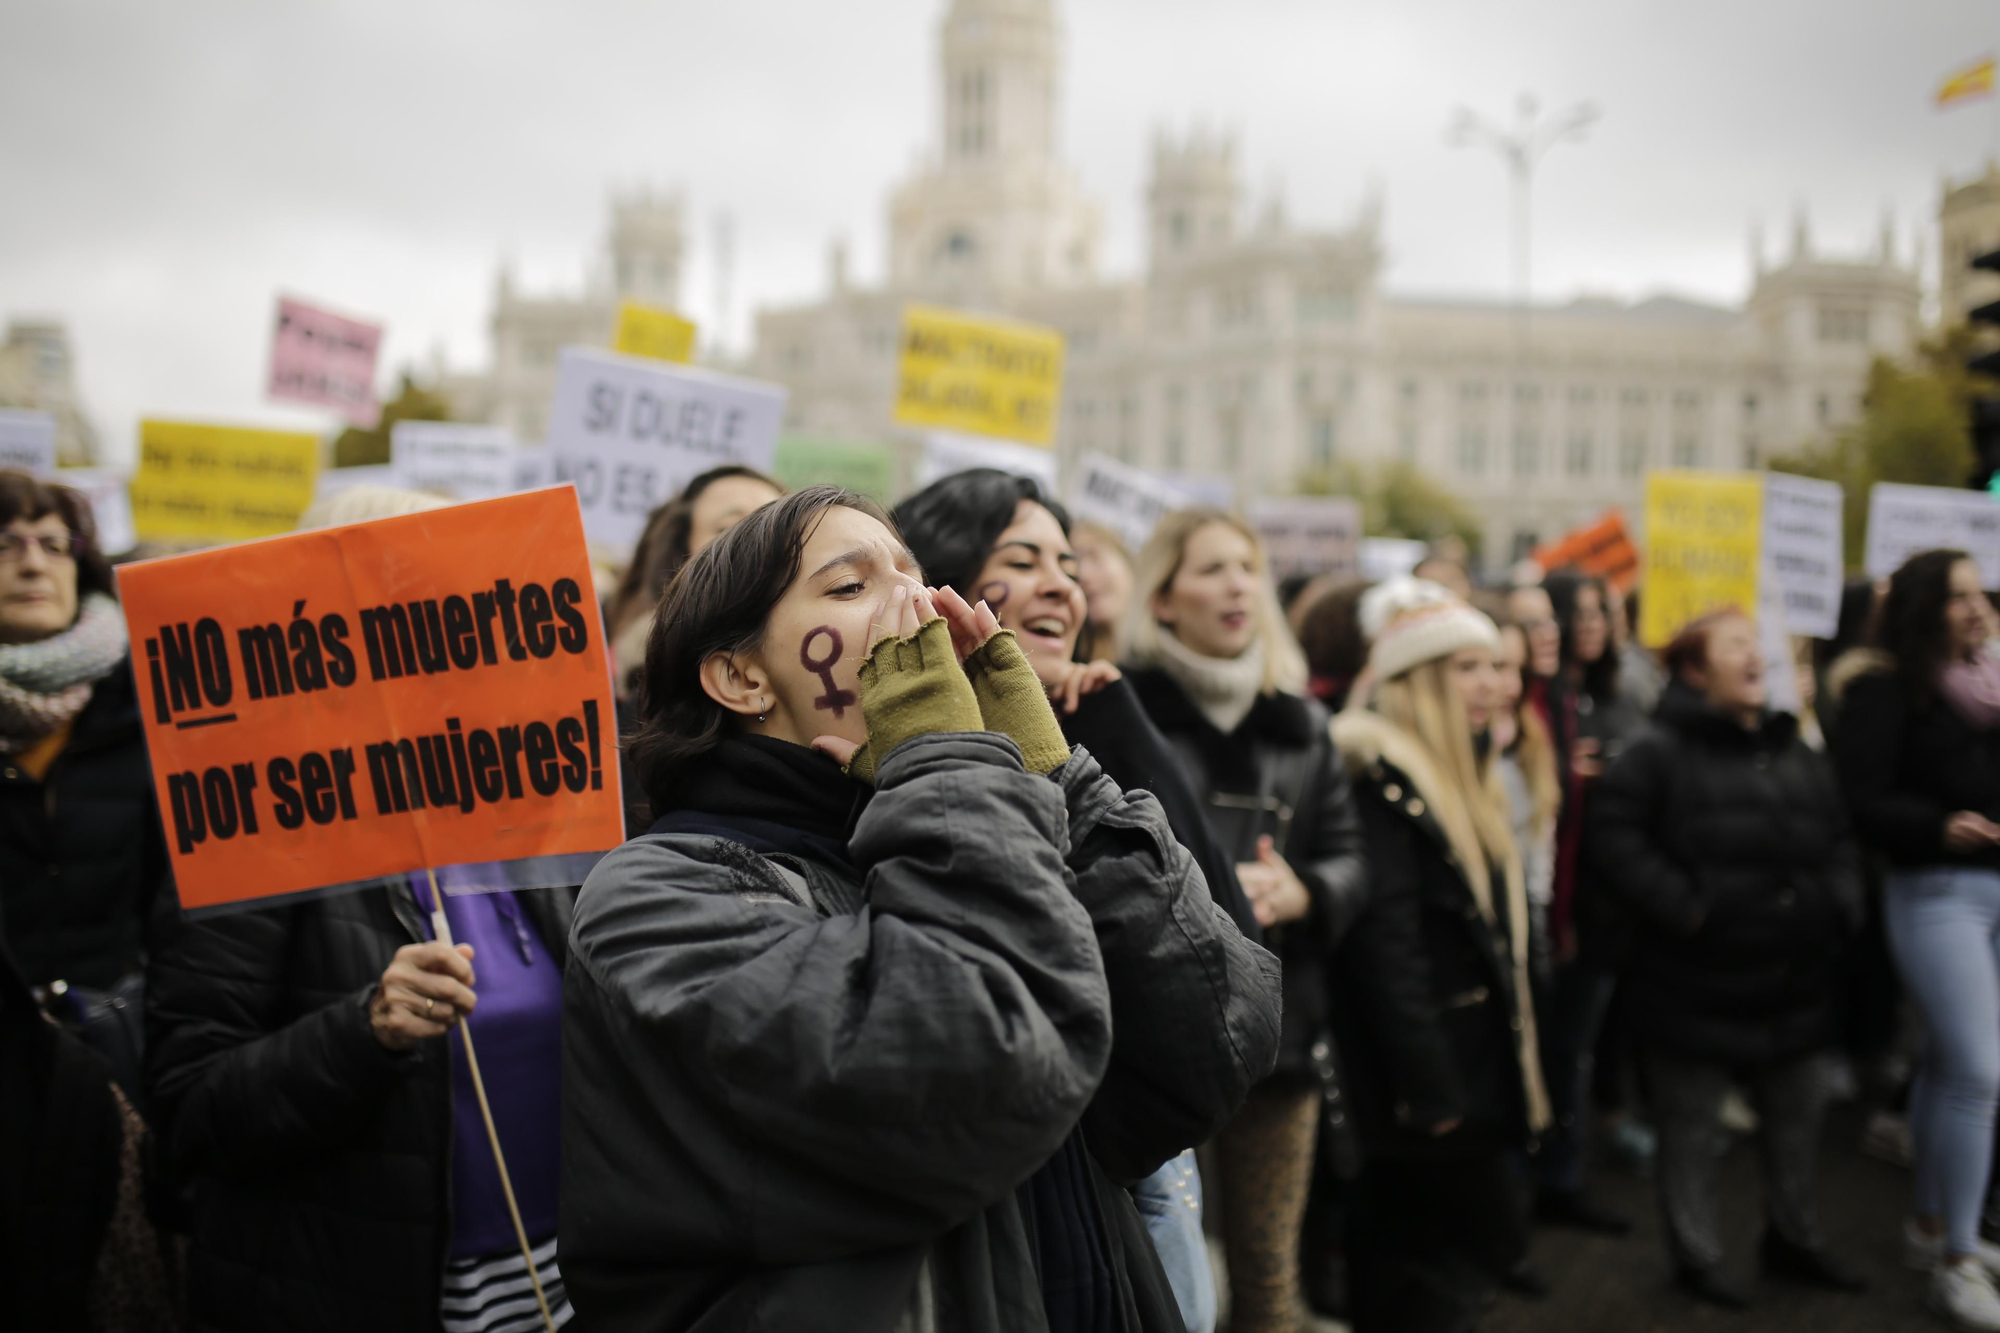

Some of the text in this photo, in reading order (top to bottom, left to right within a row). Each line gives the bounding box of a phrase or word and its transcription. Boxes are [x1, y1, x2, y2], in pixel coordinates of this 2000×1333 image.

[584, 377, 749, 454] SI DUELE
[145, 578, 589, 726] ¡NO más muertes
[167, 700, 604, 855] por ser mujeres!
